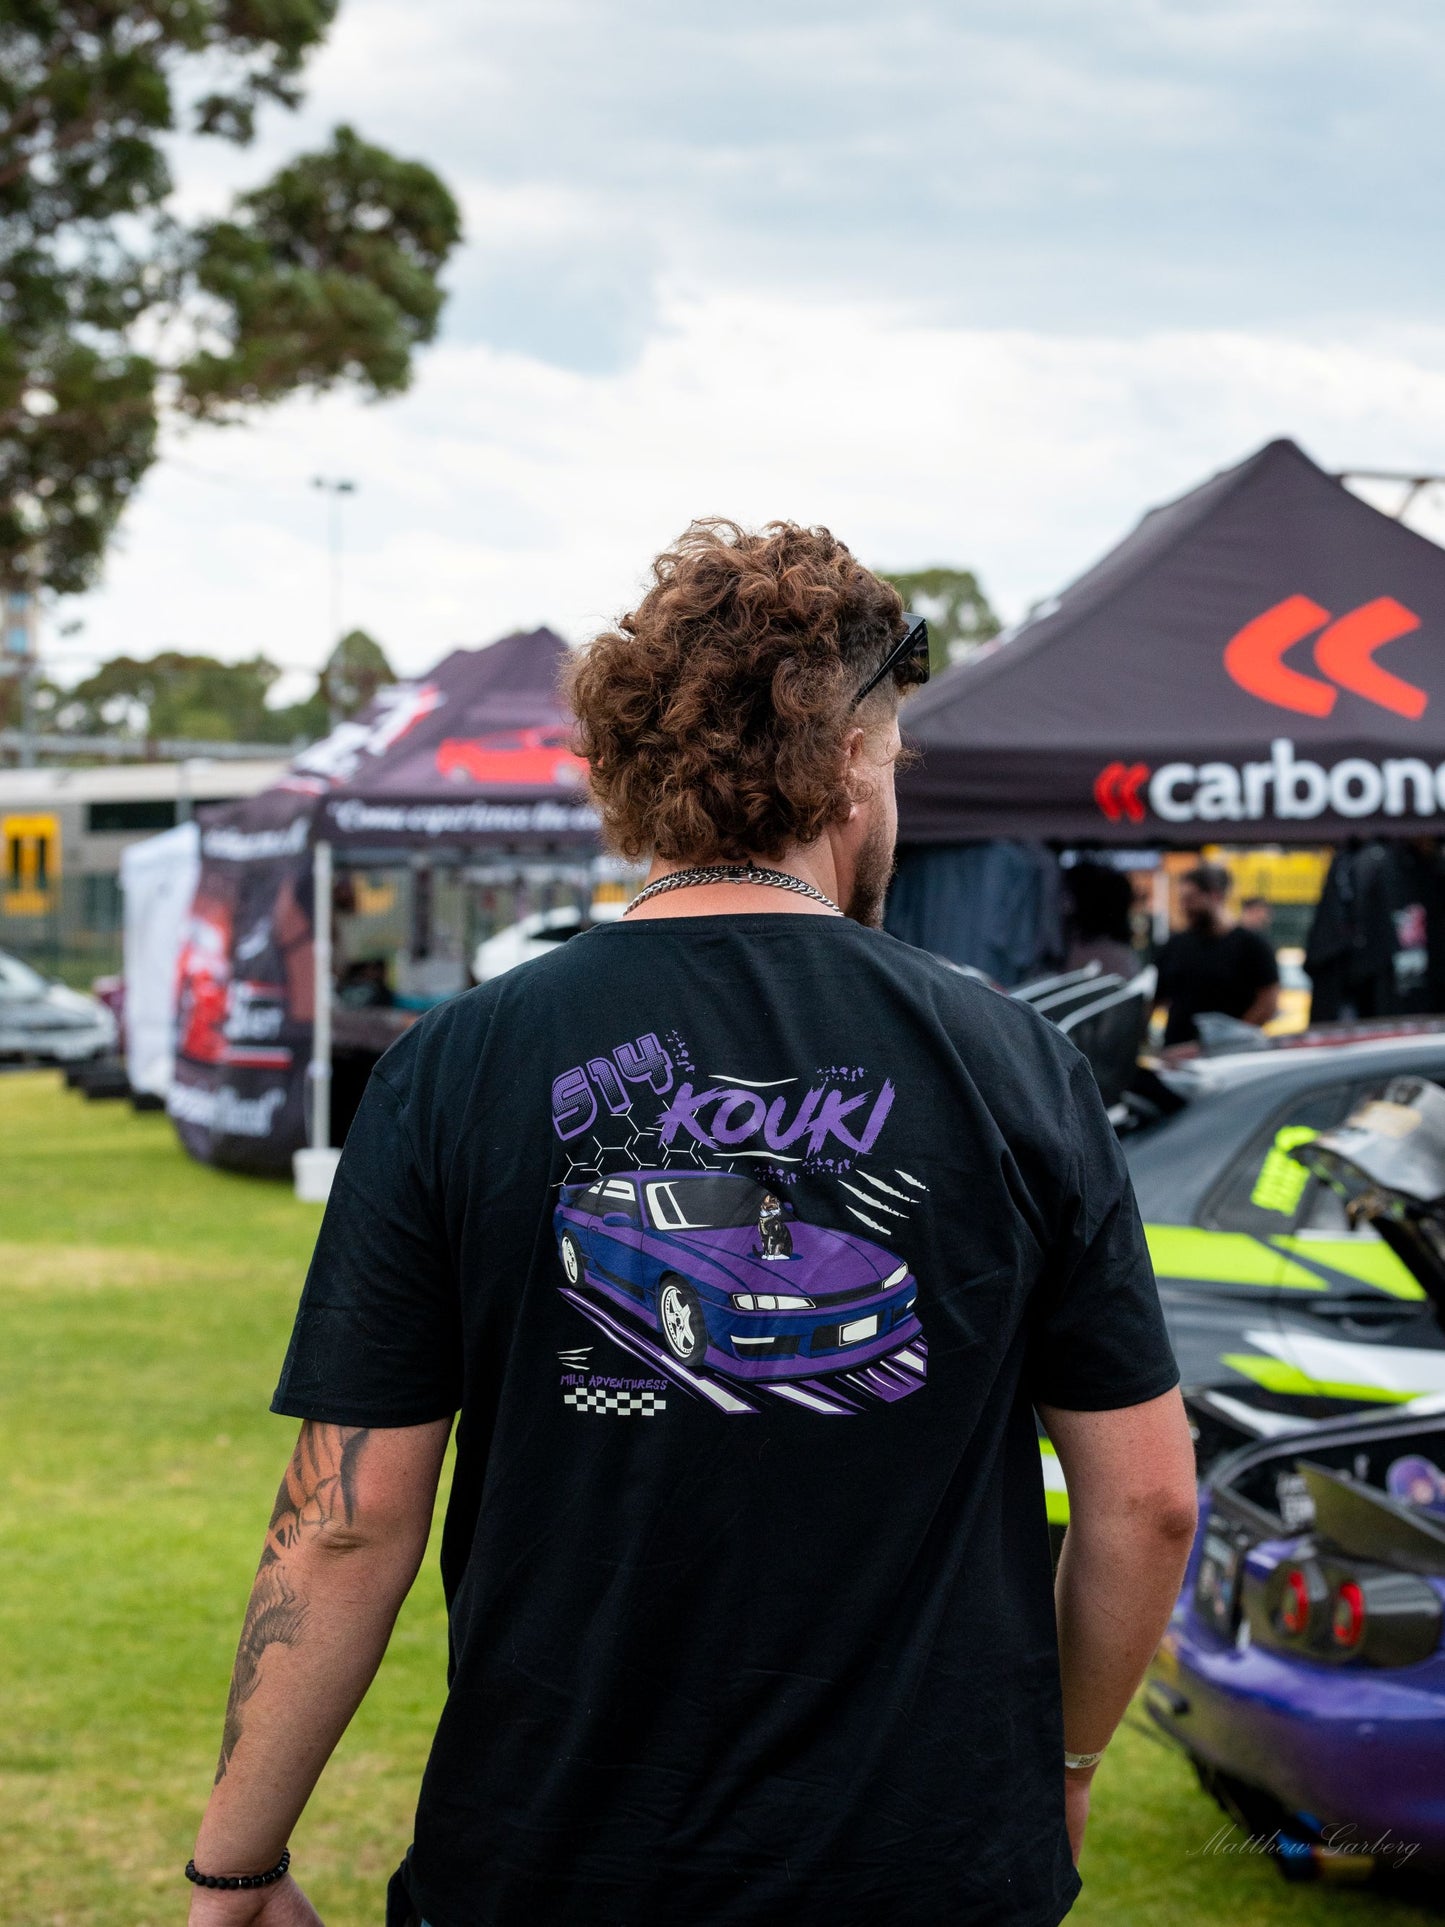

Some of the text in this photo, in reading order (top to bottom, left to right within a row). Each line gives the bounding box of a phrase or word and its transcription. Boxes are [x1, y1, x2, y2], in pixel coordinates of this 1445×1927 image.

[1149, 738, 1445, 822] carbon
[552, 1032, 673, 1141] S14
[655, 1078, 895, 1158] KOUKI
[560, 1374, 668, 1391] MILO ADVENTURESS
